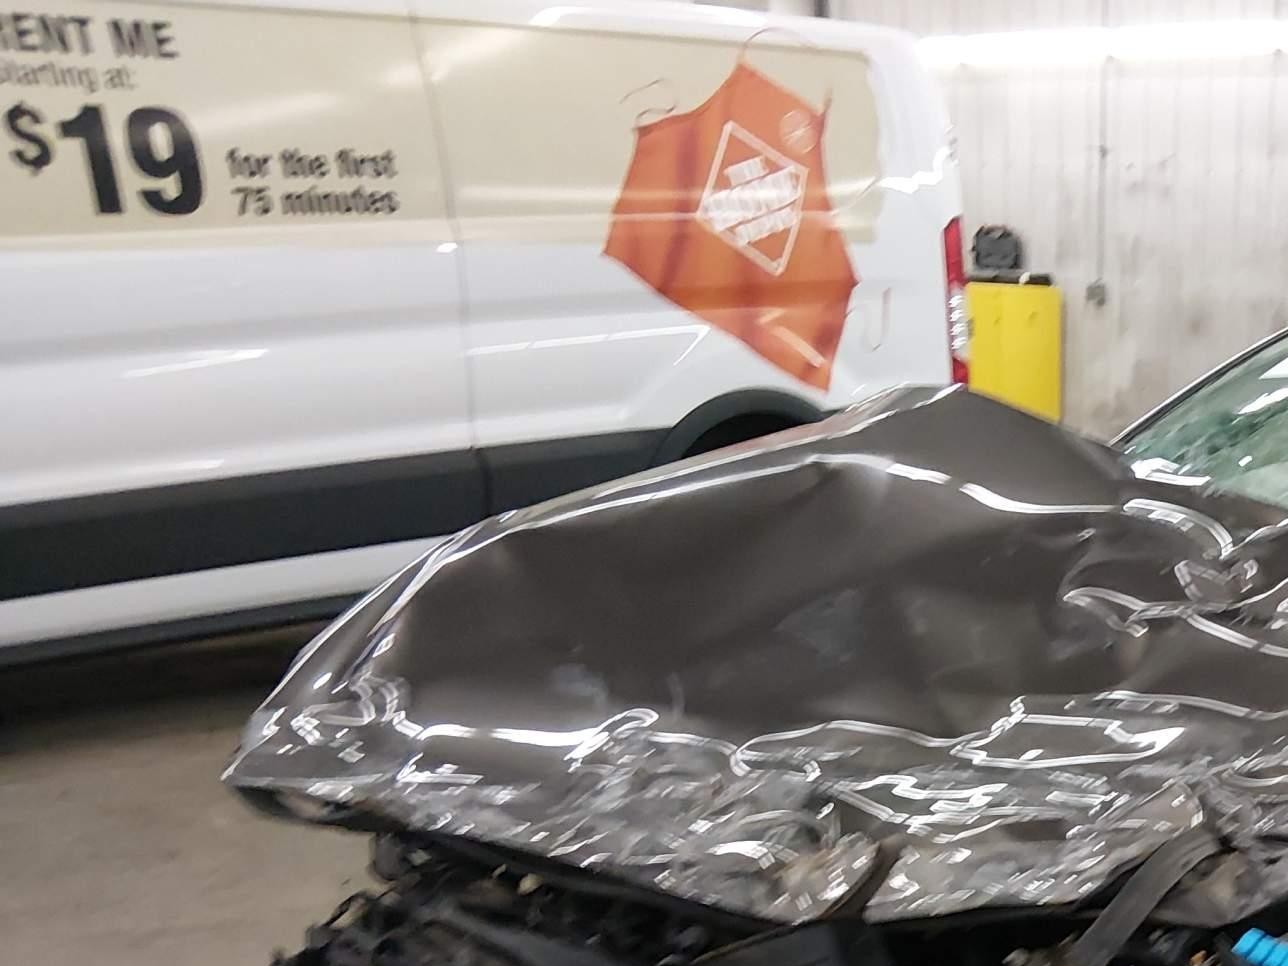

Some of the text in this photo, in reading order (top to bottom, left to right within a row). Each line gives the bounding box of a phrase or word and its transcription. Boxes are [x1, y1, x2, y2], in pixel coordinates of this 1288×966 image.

[107, 19, 178, 58] ME
[4, 103, 204, 217] $19
[226, 147, 397, 178] for the first
[232, 184, 400, 216] 75 minutes
